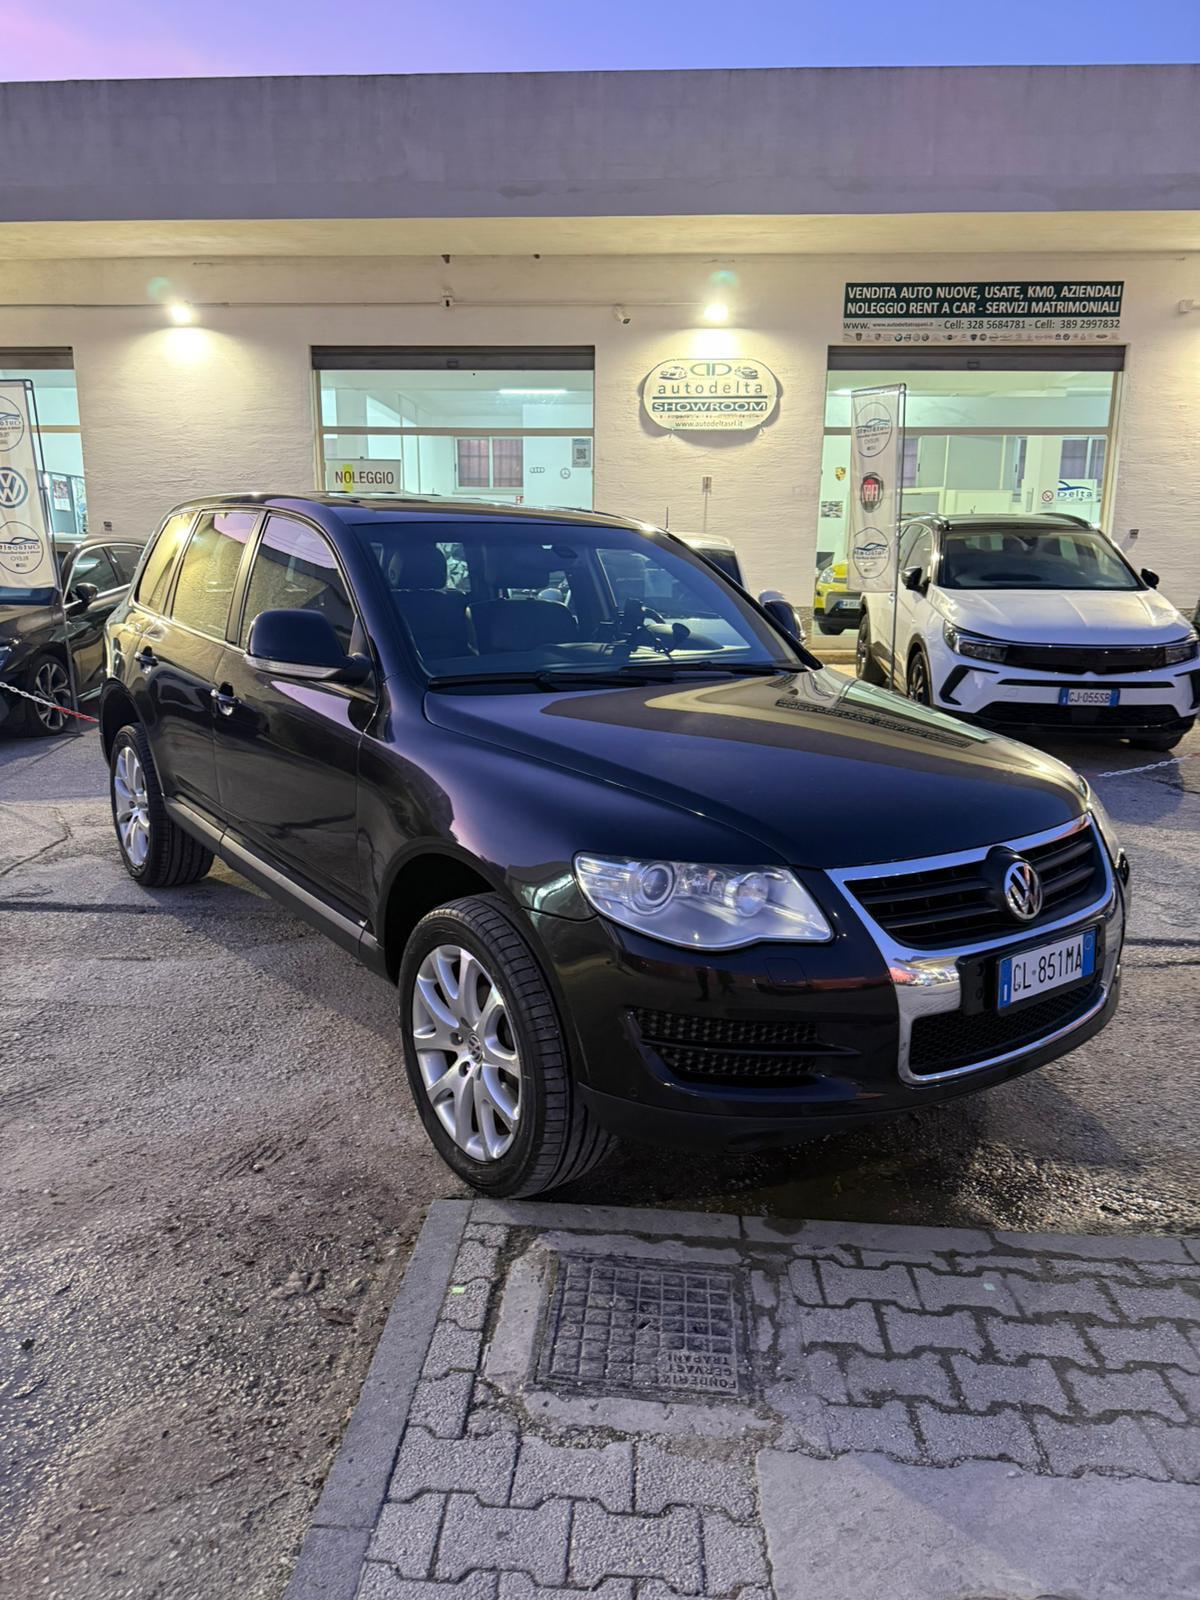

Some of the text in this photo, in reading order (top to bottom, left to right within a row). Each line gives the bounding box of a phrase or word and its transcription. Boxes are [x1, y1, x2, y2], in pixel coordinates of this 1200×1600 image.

[848, 287, 897, 298] VENDITA
[900, 287, 932, 298] AUTO
[936, 286, 980, 300] NUOVE,
[985, 286, 1024, 299] USATE,
[1061, 285, 1121, 297] AZIENDALI
[847, 303, 906, 314] NOLEGGIO
[909, 303, 939, 314] RENT
[941, 303, 950, 313] A
[953, 303, 976, 313] CAR
[985, 302, 1028, 313] SERVIZI
[1031, 302, 1119, 313] MATRIMONIALI
[944, 320, 964, 329] Cell:
[967, 320, 984, 329] 328
[986, 320, 1026, 329] 5684781
[1035, 320, 1055, 329] Cell:
[1060, 320, 1077, 329] 389
[1080, 319, 1120, 329] 2997832
[658, 381, 762, 394] autodelta
[653, 402, 766, 412] SHOWROOM
[335, 471, 394, 484] NOLEGGIO
[1058, 490, 1092, 498] Delta
[668, 1353, 729, 1365] TRAPANI
